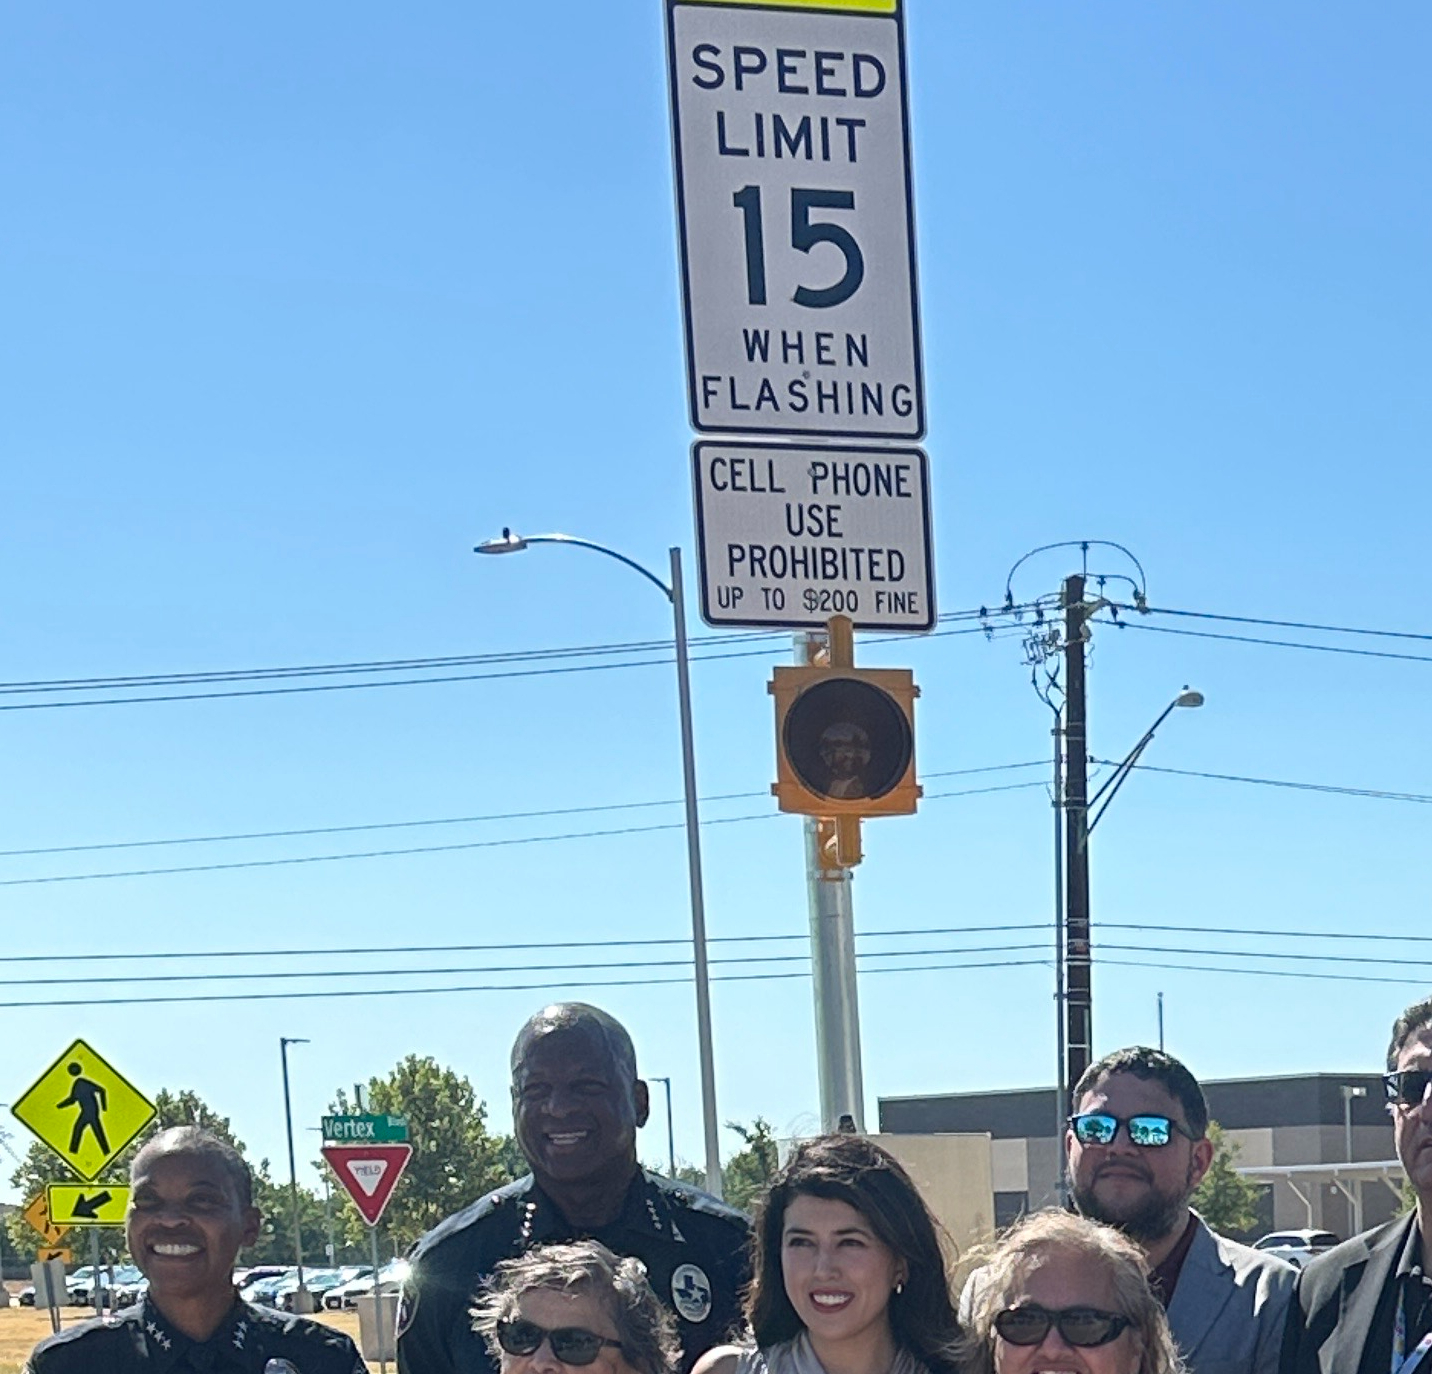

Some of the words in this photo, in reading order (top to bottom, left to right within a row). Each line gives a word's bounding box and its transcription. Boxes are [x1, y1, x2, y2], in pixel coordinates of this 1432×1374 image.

[692, 43, 886, 99] SPEED
[716, 110, 866, 163] LIMIT
[732, 184, 864, 309] 15
[742, 328, 869, 367] WHEN
[701, 375, 913, 417] FLASHING
[710, 457, 786, 493] CELL
[810, 461, 912, 497] PHONE
[785, 502, 843, 538] USE
[727, 543, 905, 582] PROHIBITED
[717, 585, 744, 609] UP
[761, 586, 785, 611] TO
[803, 588, 859, 613] $200
[875, 591, 919, 614] FINE
[323, 1118, 375, 1138] Vertex
